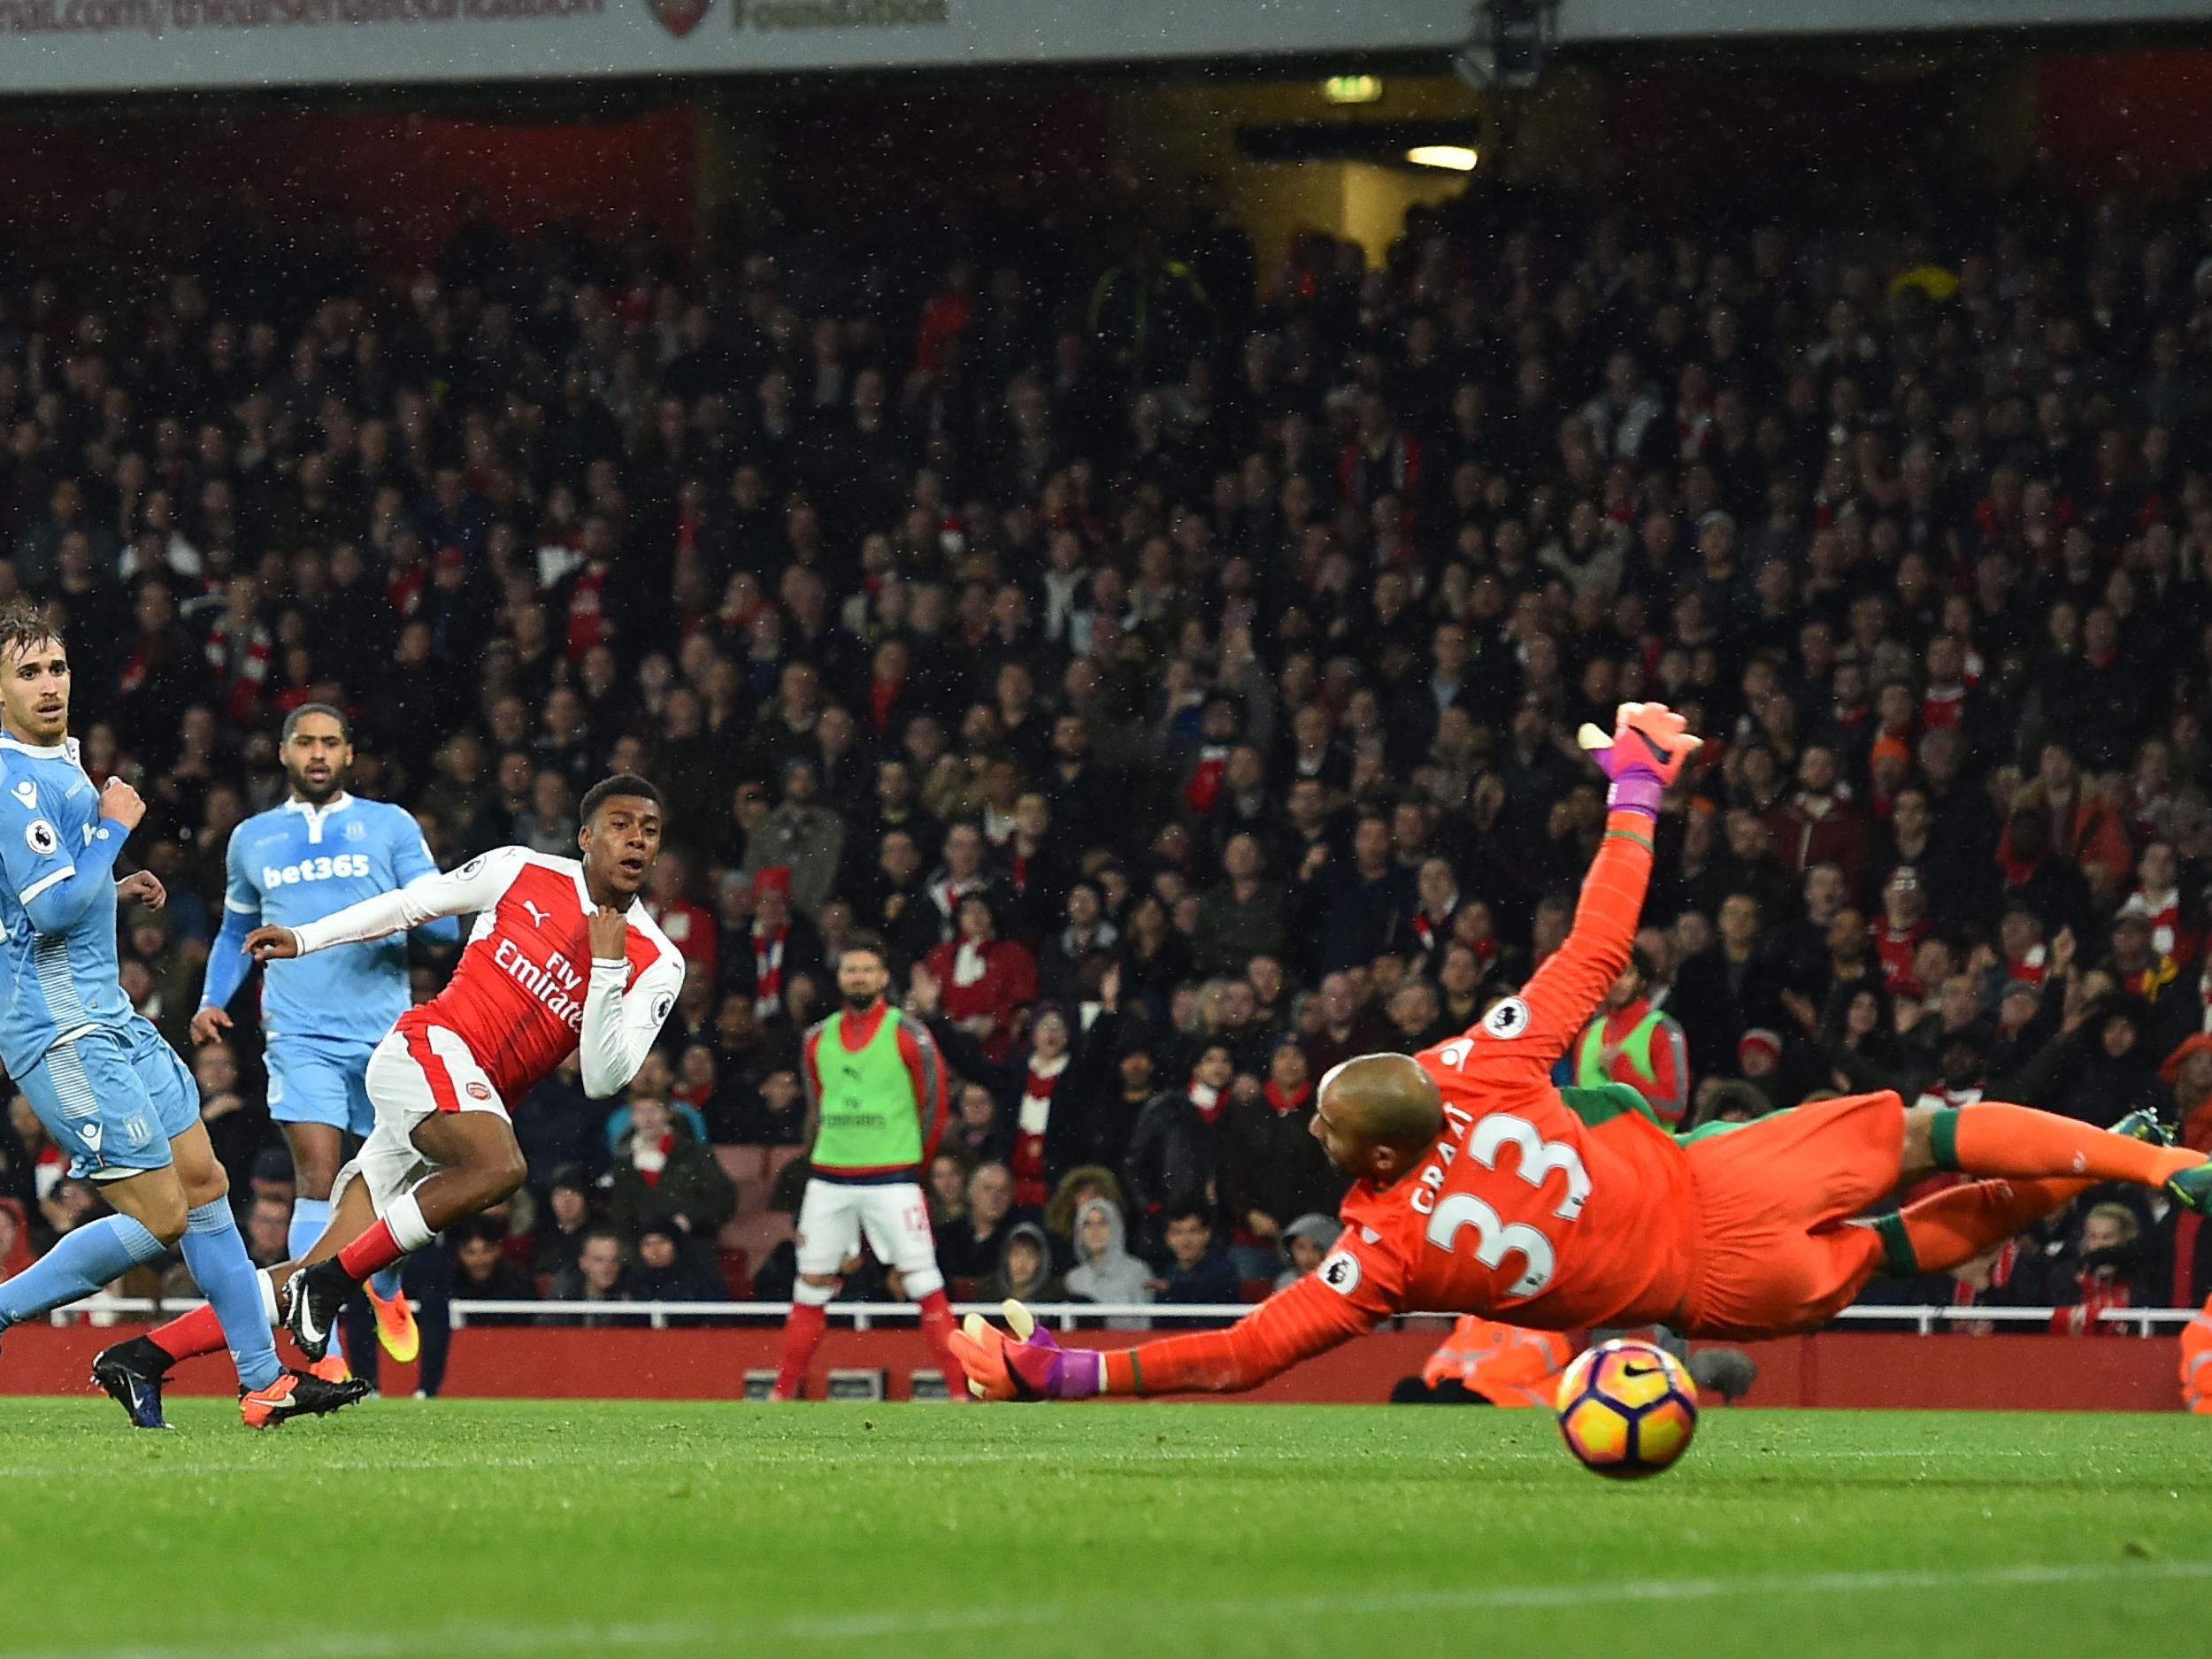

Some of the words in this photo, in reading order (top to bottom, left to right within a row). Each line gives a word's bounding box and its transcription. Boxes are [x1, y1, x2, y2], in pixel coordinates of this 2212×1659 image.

[262, 853, 369, 889] bet365
[494, 938, 584, 1033] Emirate
[545, 950, 582, 990] Fly
[1425, 1111, 1593, 1299] 33
